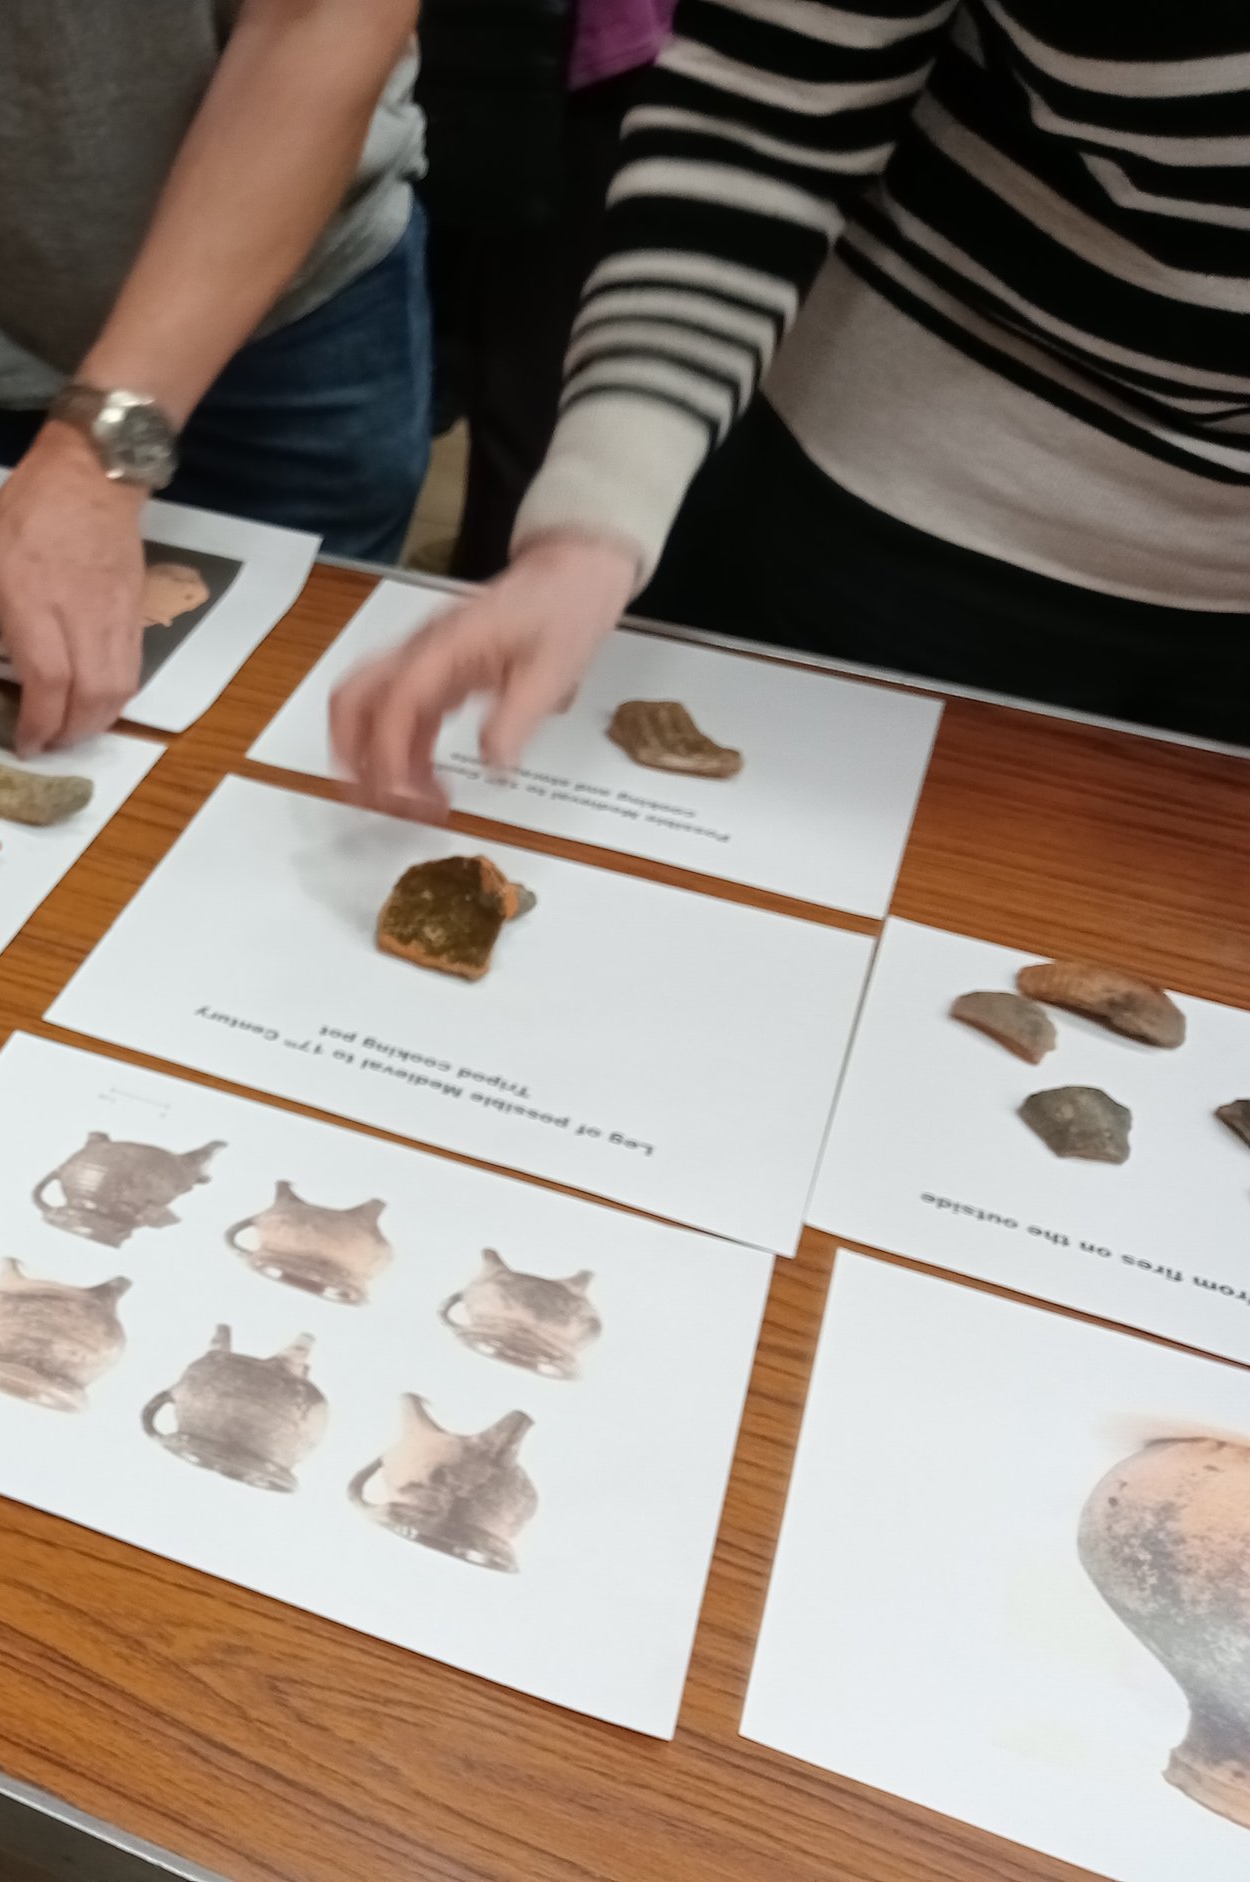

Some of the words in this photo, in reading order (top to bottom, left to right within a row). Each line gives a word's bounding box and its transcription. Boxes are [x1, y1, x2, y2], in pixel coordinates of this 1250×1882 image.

[195, 1004, 280, 1042] Century
[319, 1024, 357, 1044] pot
[332, 1048, 354, 1064] to
[362, 1035, 452, 1072] cooking
[360, 1057, 463, 1098] Medieval
[456, 1066, 530, 1099] Tripod
[469, 1091, 570, 1128] possible
[574, 1124, 601, 1138] of
[608, 1131, 654, 1156] Leg
[920, 1192, 1018, 1229] outside
[1026, 1225, 1070, 1247] the
[1078, 1241, 1111, 1258] on
[1120, 1254, 1183, 1283] fires
[1193, 1275, 1250, 1306] rom
